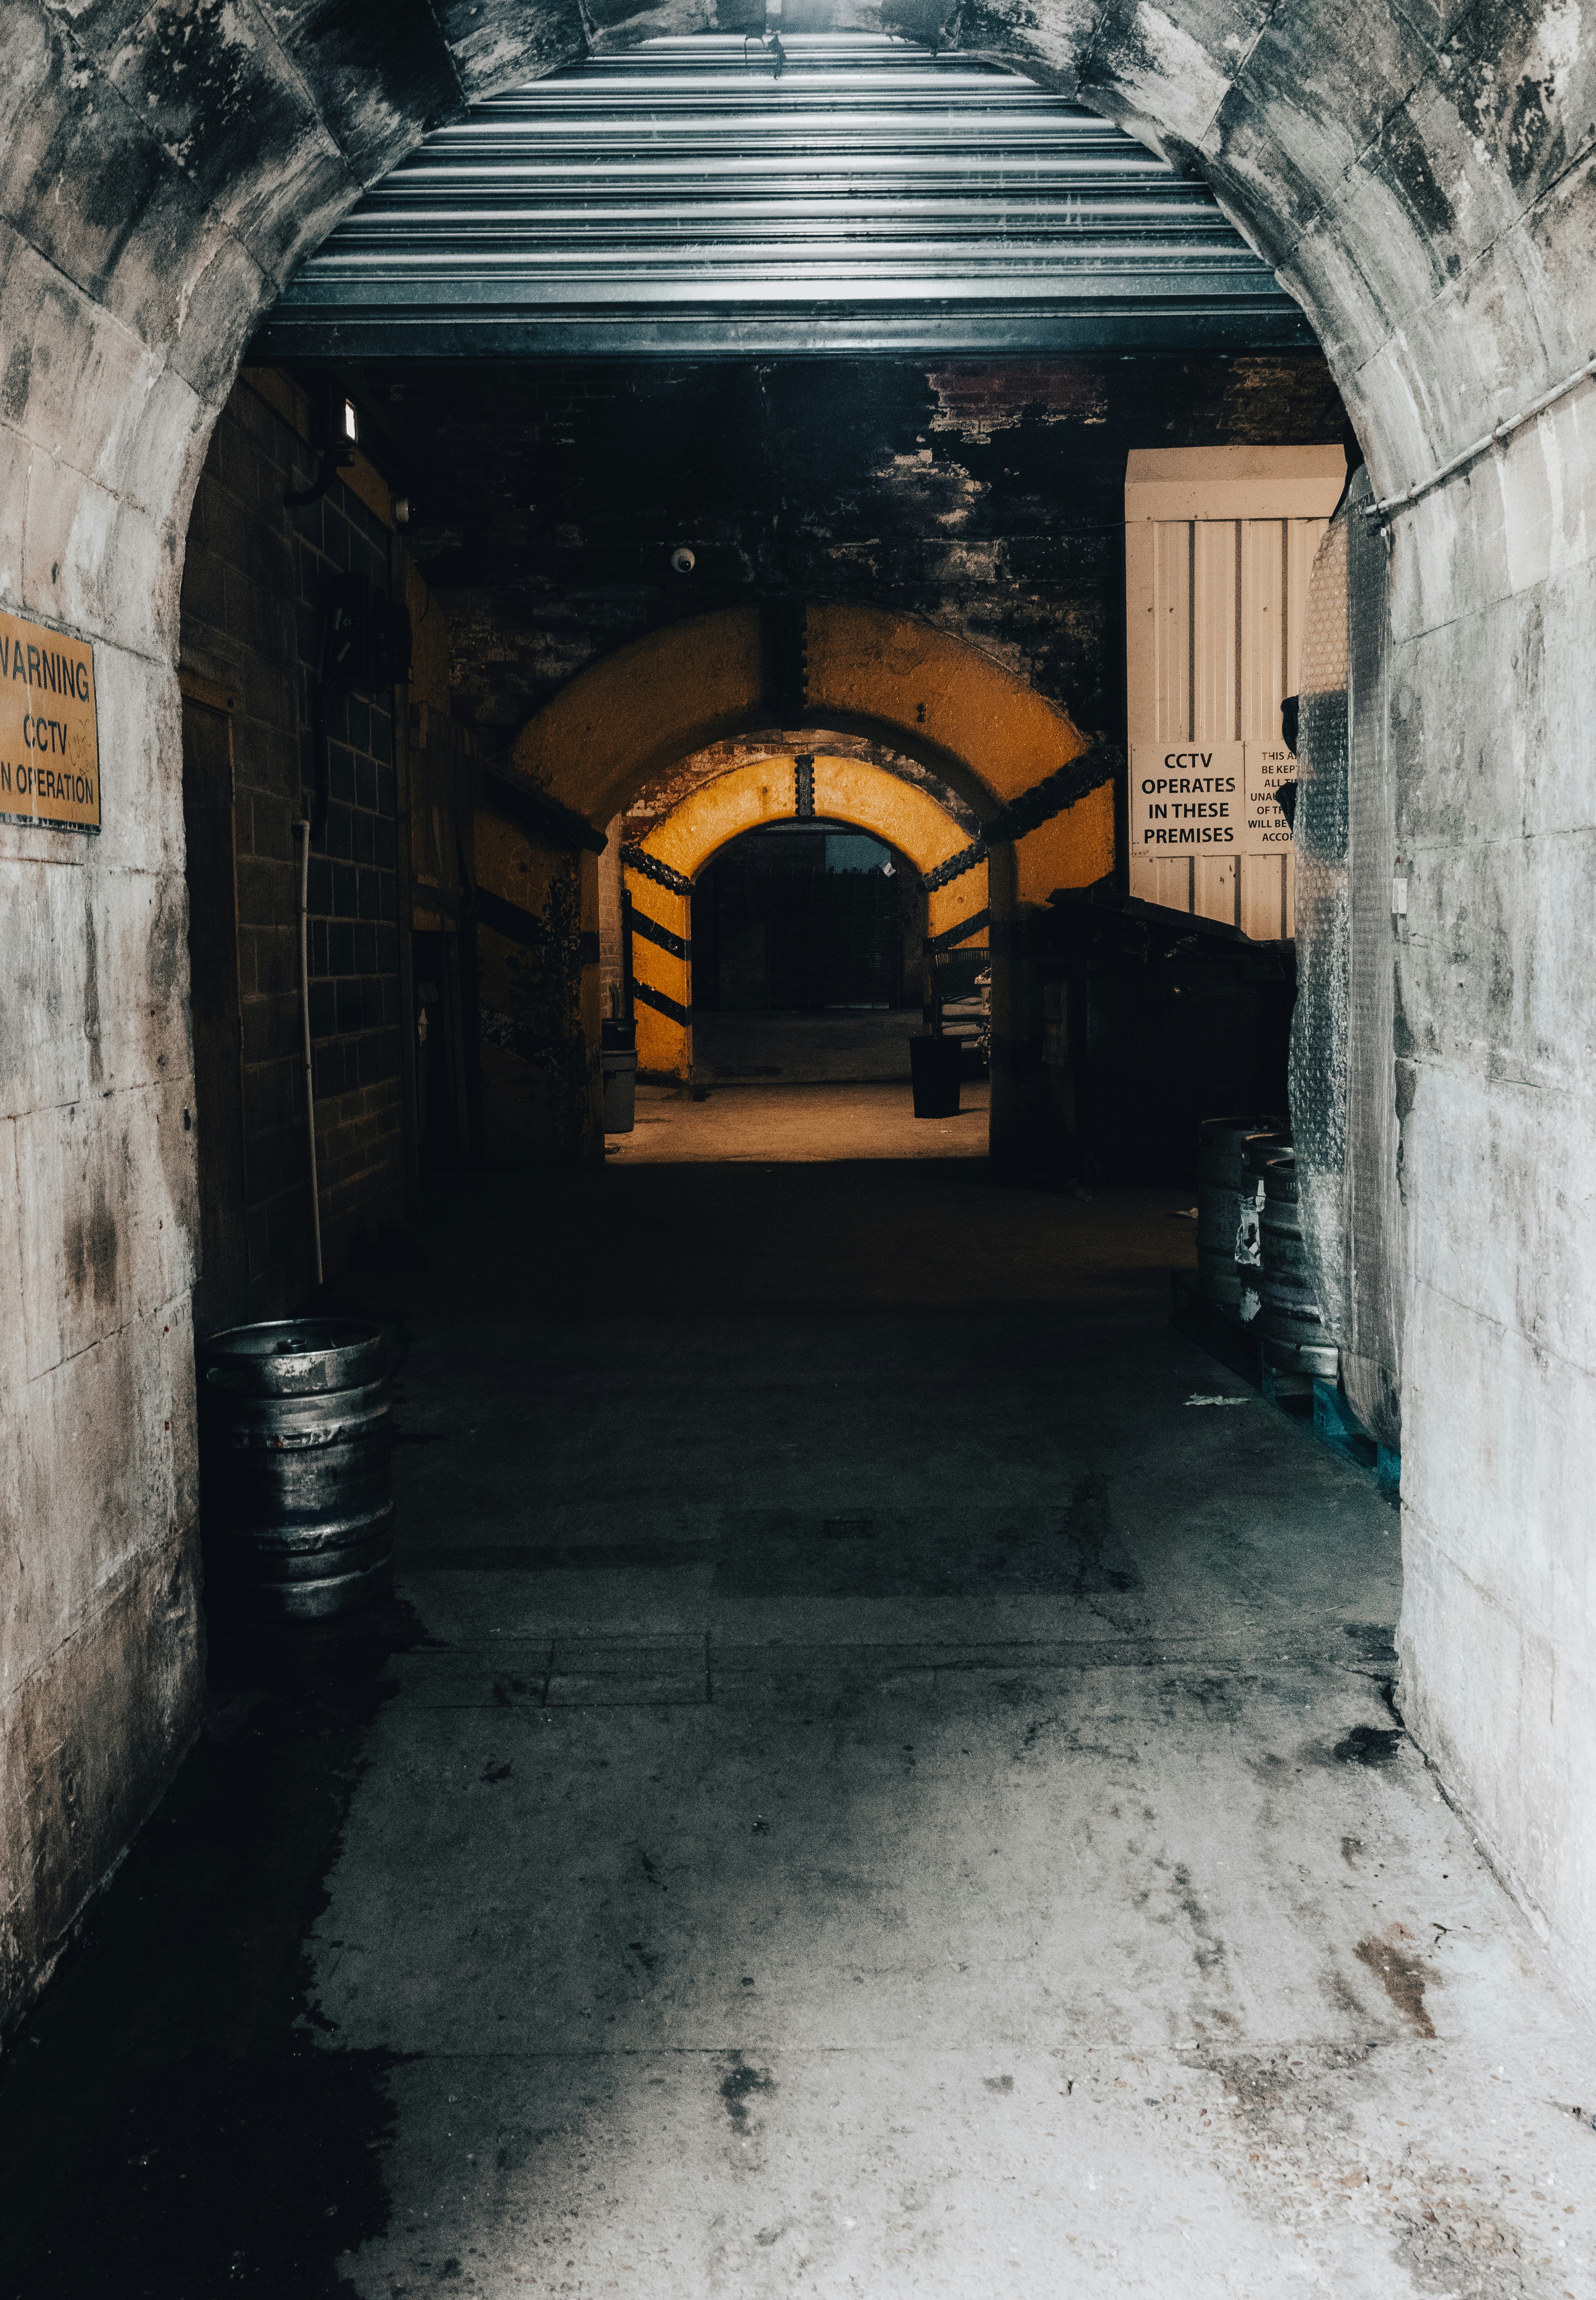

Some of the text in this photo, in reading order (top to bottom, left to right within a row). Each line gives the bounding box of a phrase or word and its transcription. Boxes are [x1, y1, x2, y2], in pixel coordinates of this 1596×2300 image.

[23, 713, 67, 755] CCTV
[1164, 753, 1213, 769] CCTV
[1262, 752, 1284, 760] THIS
[16, 764, 93, 805] OPERATION
[1142, 777, 1235, 794] OPERATES
[1264, 779, 1282, 787] ALL
[1149, 802, 1229, 819] IN THESE
[1257, 806, 1270, 814] OF
[1248, 819, 1287, 828] WILL BE
[1144, 827, 1234, 844] PREMISES
